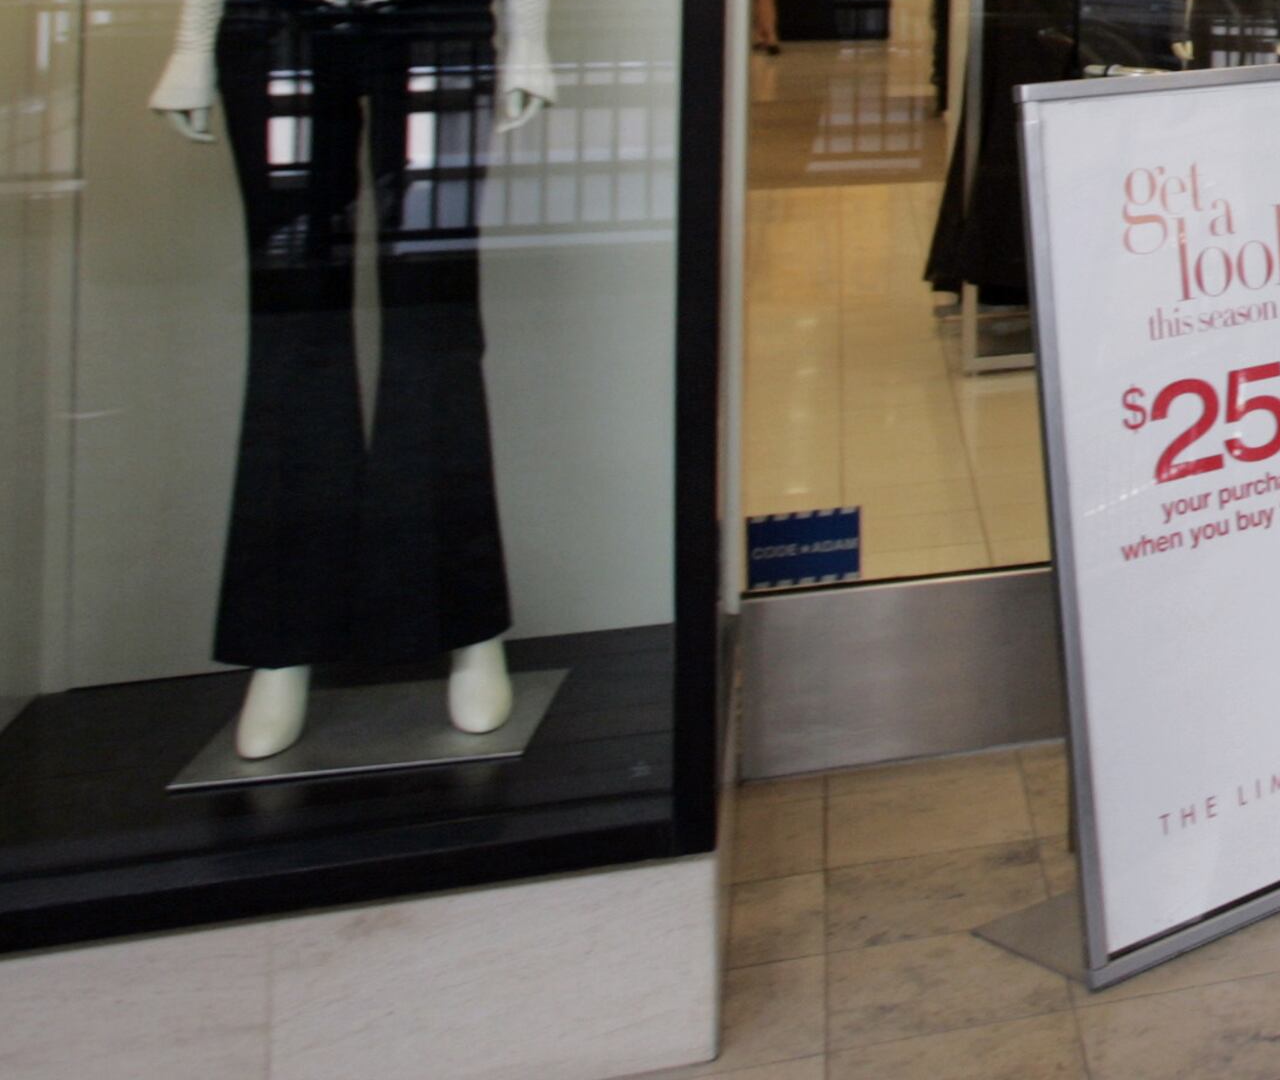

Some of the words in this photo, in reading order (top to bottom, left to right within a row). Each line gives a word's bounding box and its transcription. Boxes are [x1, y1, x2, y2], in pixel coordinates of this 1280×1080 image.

[1122, 163, 1204, 255] get
[1209, 198, 1236, 237] a
[1148, 307, 1195, 341] this
[1197, 301, 1279, 333] season
[1161, 492, 1212, 524] your
[751, 543, 798, 561] CODE
[811, 537, 859, 554] ADAM
[1120, 531, 1184, 562] when
[1189, 519, 1230, 549] you
[1236, 507, 1275, 530] buy
[1158, 795, 1219, 837] THE
